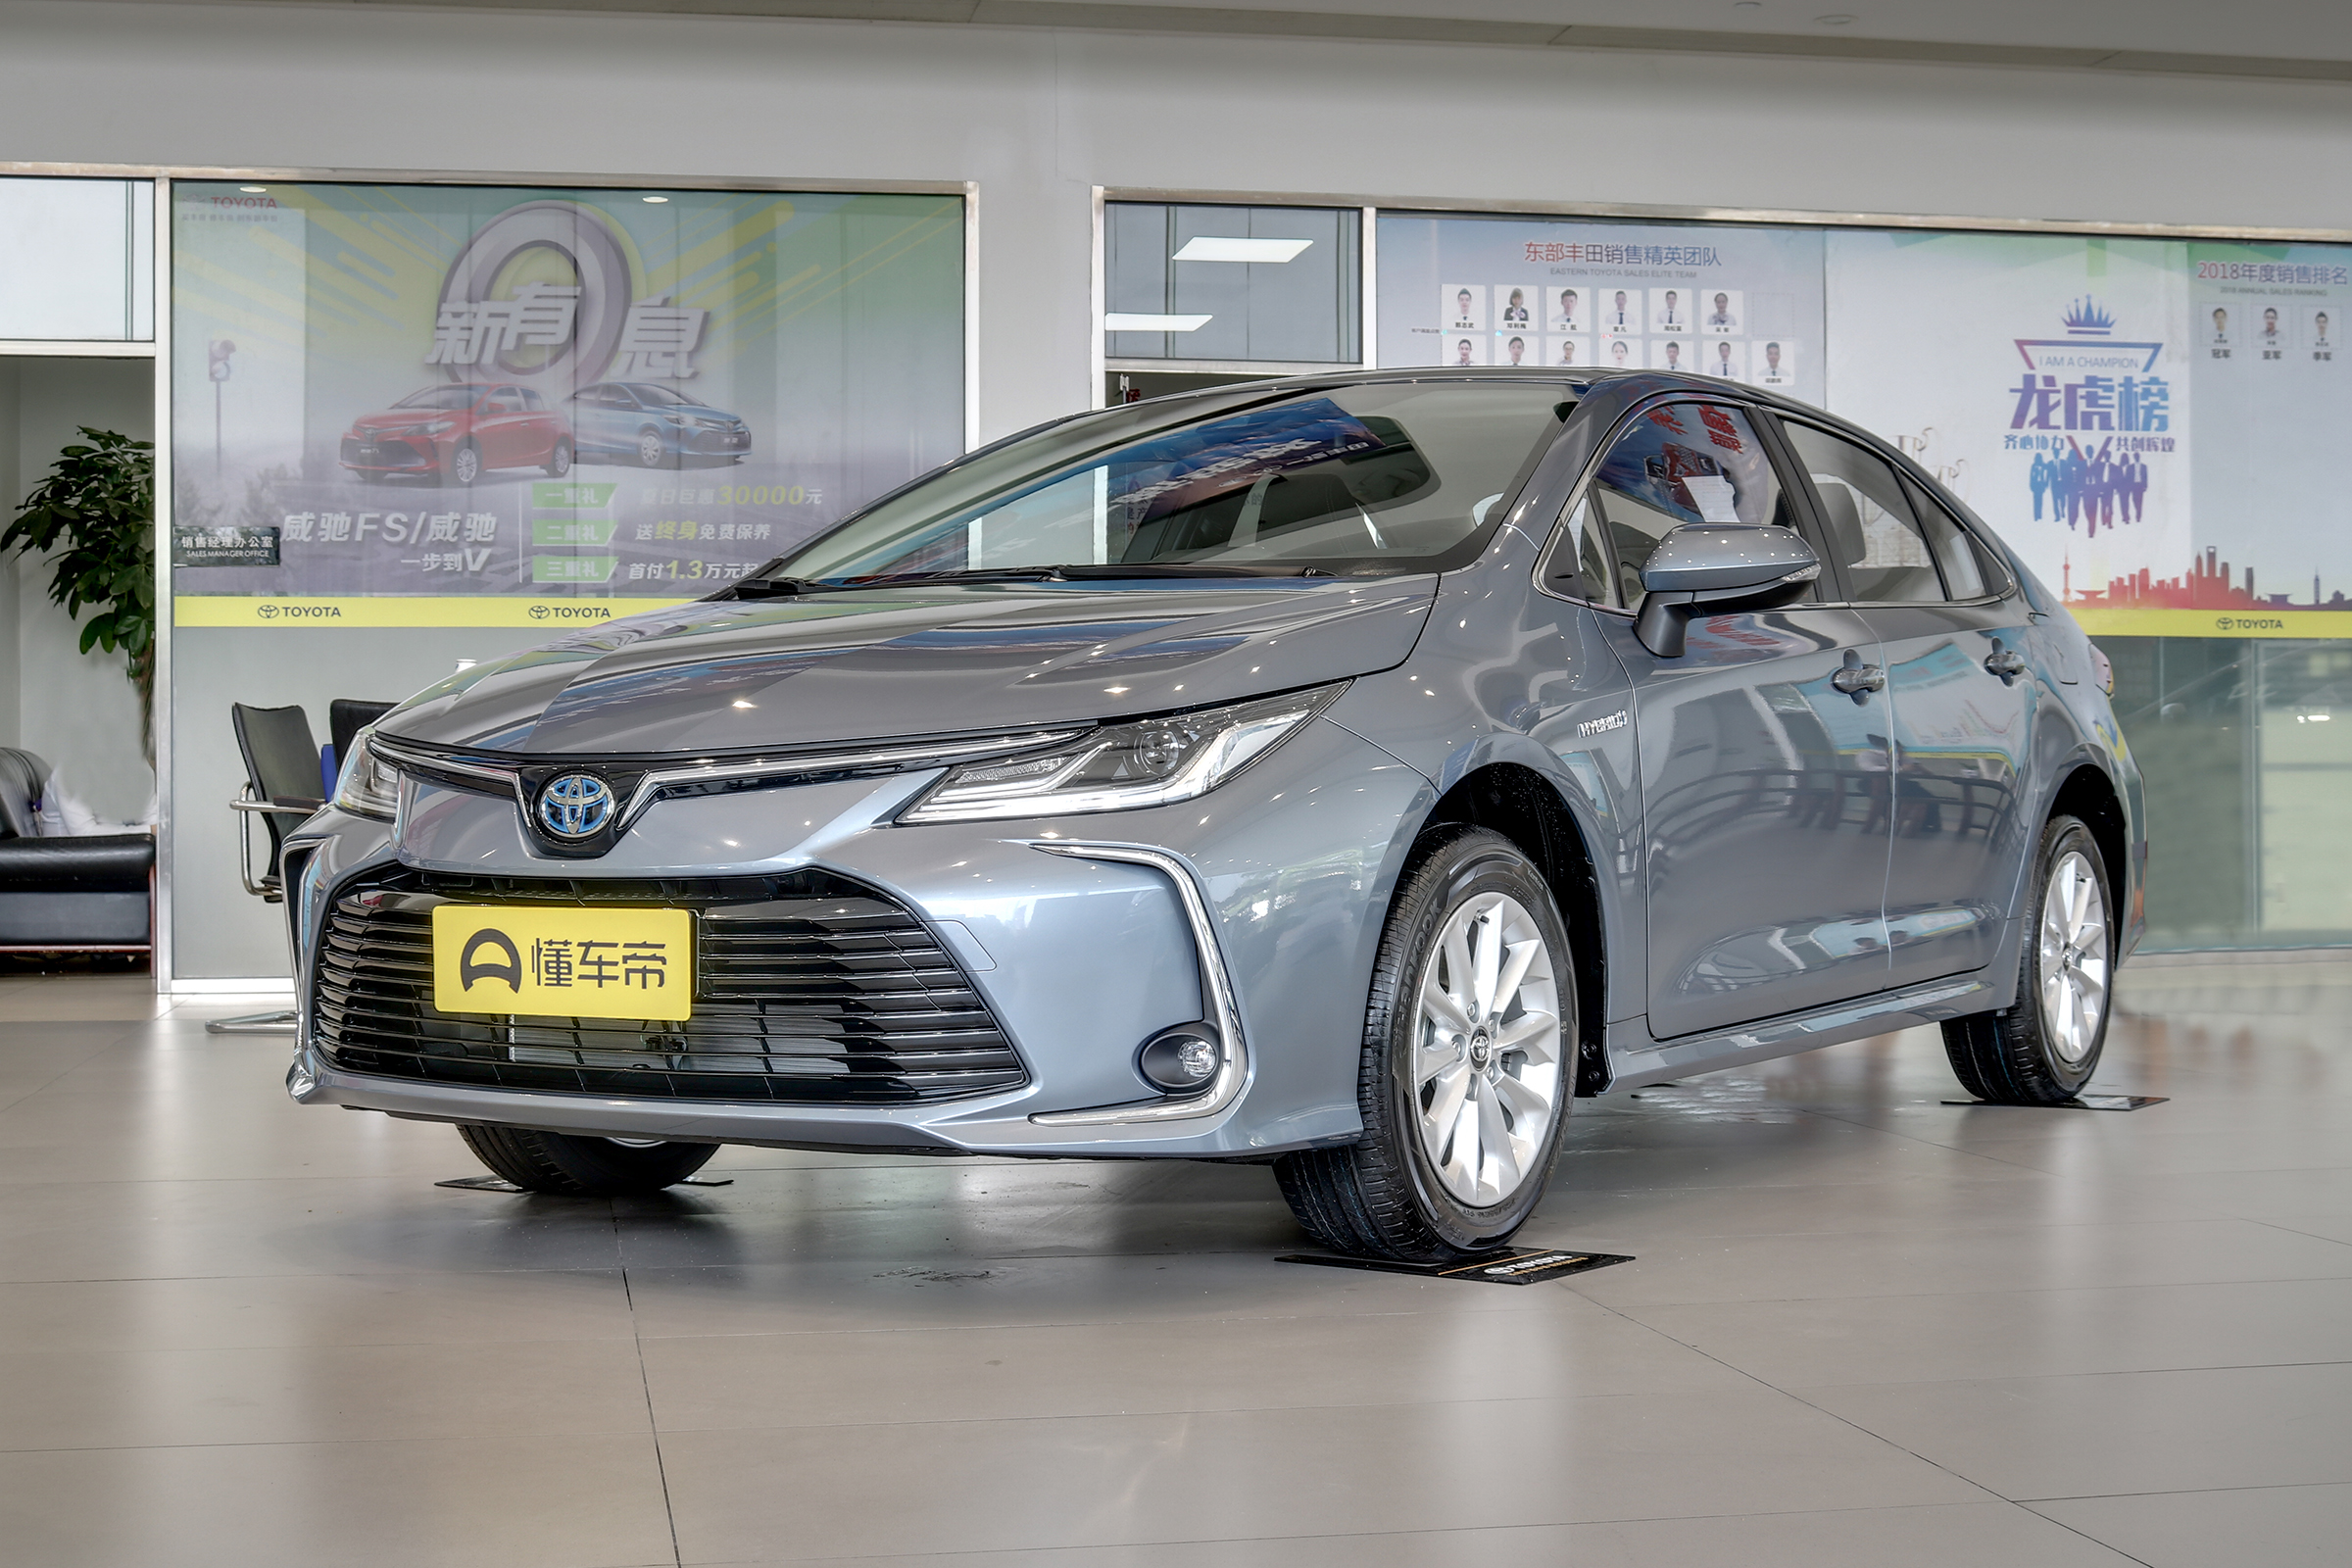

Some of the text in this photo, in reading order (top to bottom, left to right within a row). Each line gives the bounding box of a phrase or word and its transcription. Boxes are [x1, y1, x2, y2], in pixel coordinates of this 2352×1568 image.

[211, 197, 277, 209] TOYOTA
[1524, 241, 1723, 267] 东部丰田销售精英团队
[1590, 268, 1622, 276] TOYOTA
[1624, 269, 1650, 277] SALES
[2197, 262, 2348, 285] 2018年度销售排名
[2045, 357, 2064, 367] AM
[2067, 358, 2075, 367] A
[2077, 357, 2139, 368] CHAMPION
[2009, 373, 2169, 431] 龙虎榜
[2004, 434, 2065, 450] 齐心协力
[2116, 436, 2176, 453] 共创辉煌
[281, 512, 498, 543] 威驰FS/威驰
[635, 520, 771, 540] 送终身免费保养
[181, 535, 273, 548] 销售经理办公室
[400, 548, 493, 571] 一步到V
[282, 606, 342, 617] TOYOTA
[553, 607, 611, 618] TOYOTA
[2235, 618, 2283, 629] TOYOTA
[530, 938, 667, 990] 懂车帝
